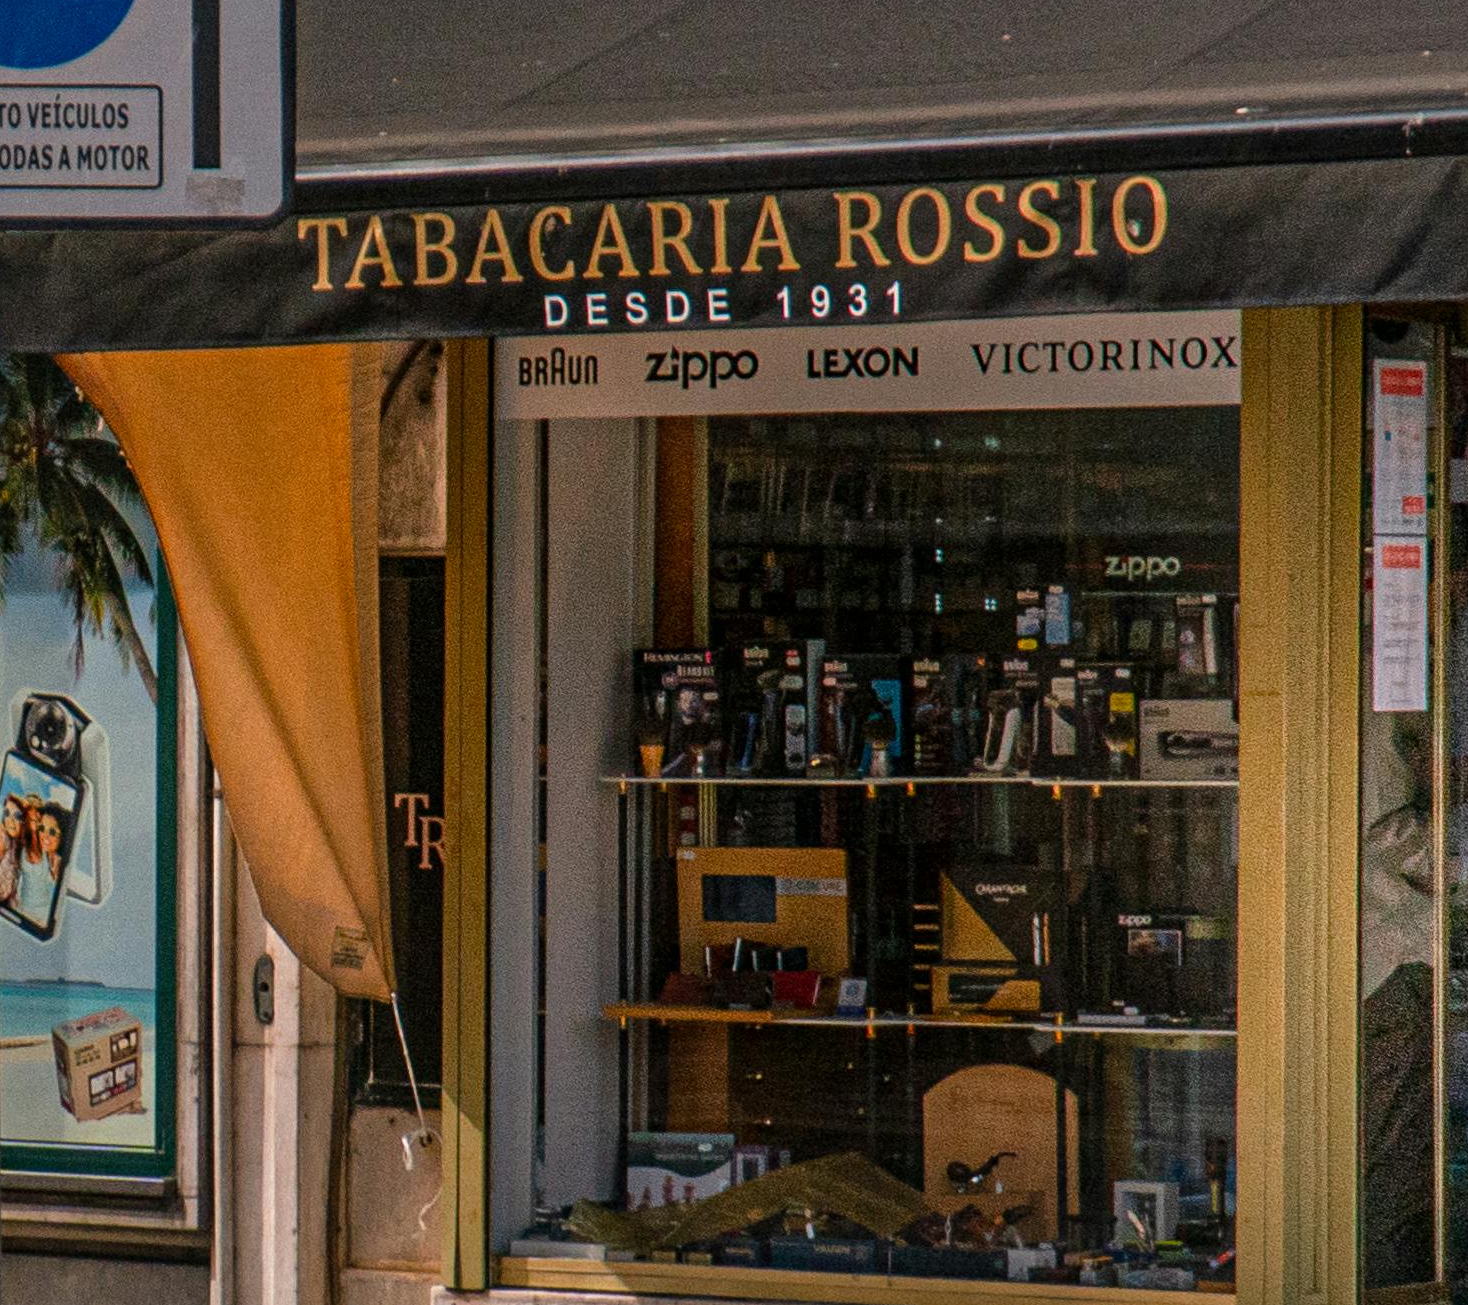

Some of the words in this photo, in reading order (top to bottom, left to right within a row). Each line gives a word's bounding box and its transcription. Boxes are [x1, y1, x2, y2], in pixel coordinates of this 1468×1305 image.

[28, 94, 130, 129] VEÍCULOS
[58, 144, 71, 170] A
[77, 143, 151, 171] MOTOR
[298, 189, 803, 292] TABACARIA
[834, 174, 1169, 270] ROSSIO
[545, 286, 732, 329] DESDE
[777, 281, 906, 322] 1931
[807, 346, 920, 380] LEXON
[972, 334, 1239, 375] VICTORINOX
[1104, 555, 1182, 582] zippo
